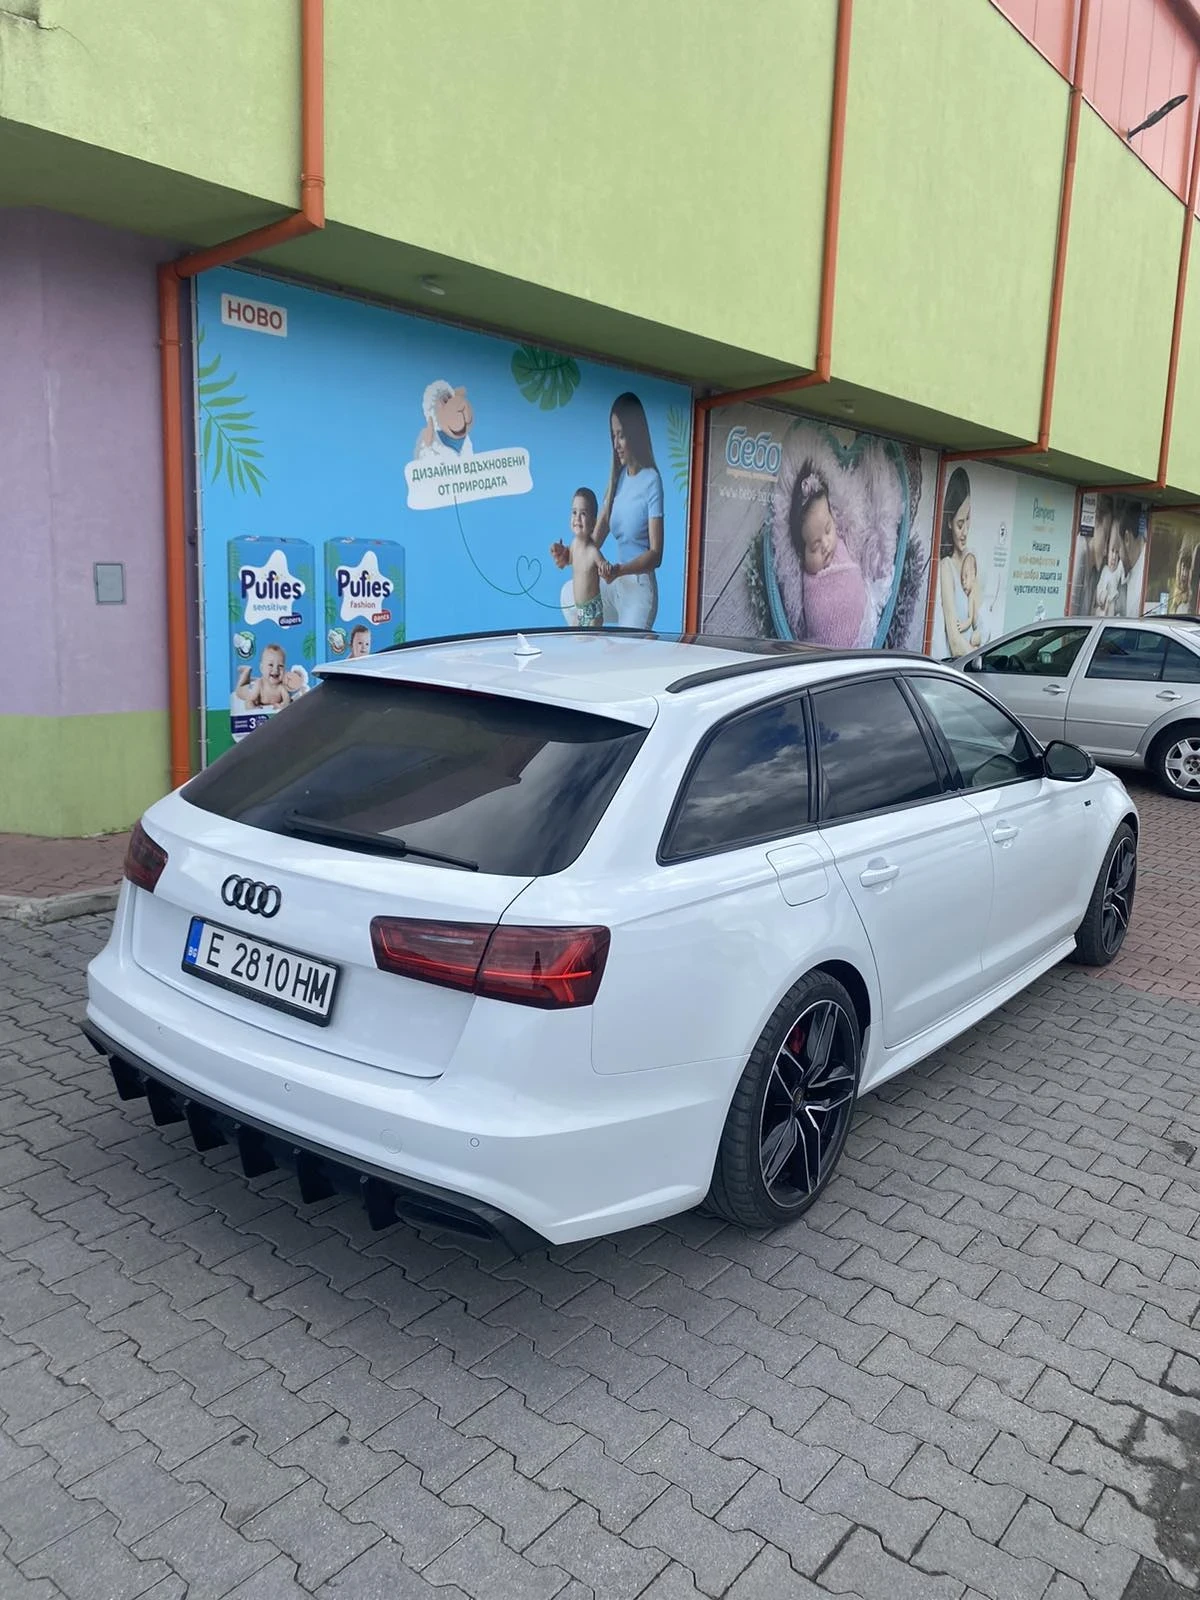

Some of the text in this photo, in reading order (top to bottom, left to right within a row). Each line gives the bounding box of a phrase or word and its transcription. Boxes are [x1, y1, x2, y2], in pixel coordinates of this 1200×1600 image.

[228, 300, 282, 330] НОВО
[726, 426, 781, 473] бебо
[411, 455, 526, 481] ДИЗАЙНИ ВДЪХНОВЕНИ
[438, 476, 508, 496] ОТ ПРИРОДАТА
[1033, 497, 1055, 524] Pampers
[241, 570, 302, 600] Pufies
[338, 569, 390, 598] Pufies
[253, 602, 288, 612] sensitive
[350, 601, 376, 609] fashion
[280, 616, 302, 625] diapers
[373, 613, 390, 622] pants
[248, 717, 257, 729] 3
[188, 946, 197, 958] BG
[206, 932, 224, 968] E
